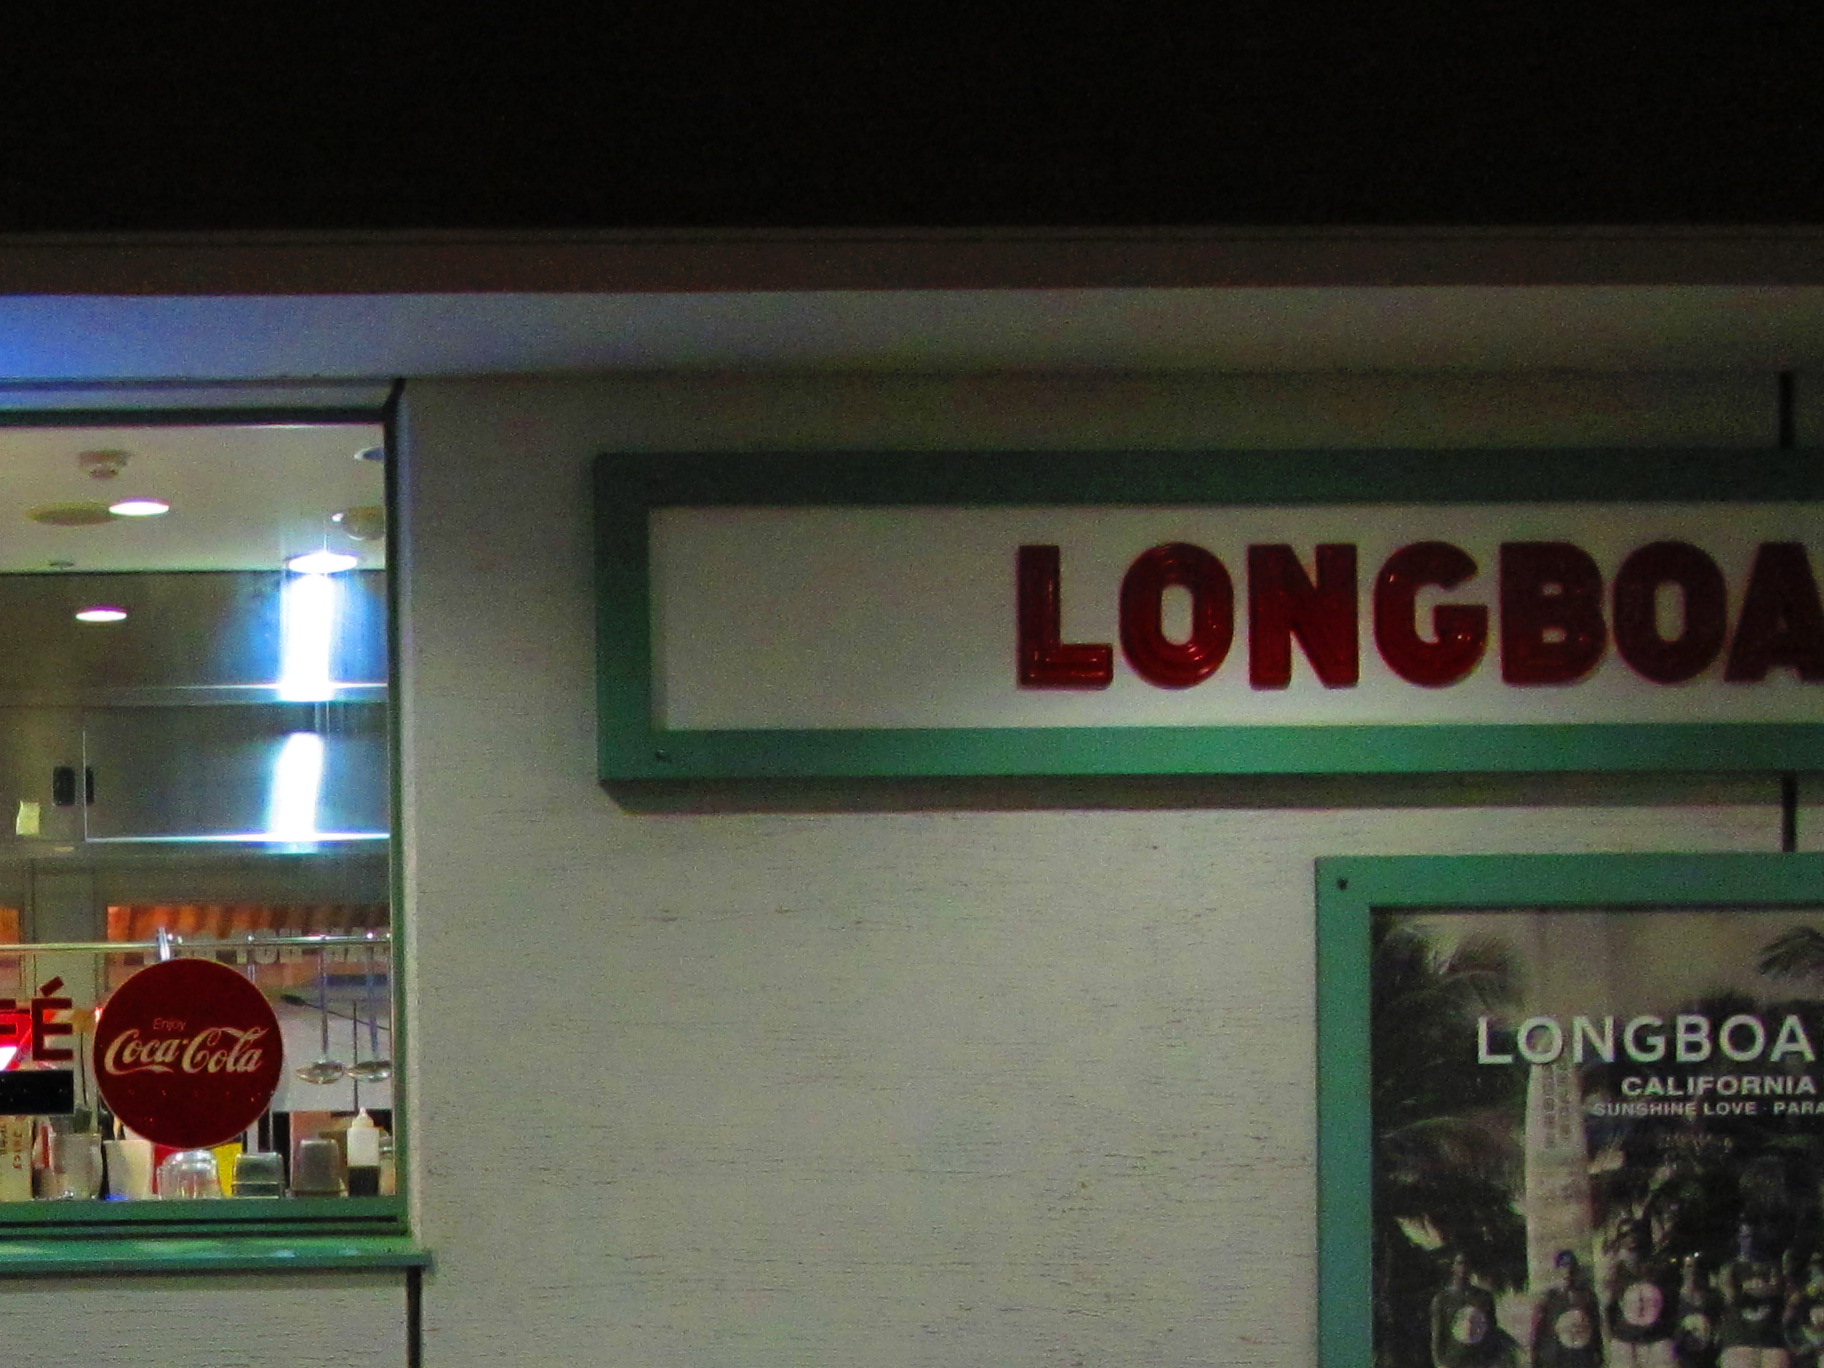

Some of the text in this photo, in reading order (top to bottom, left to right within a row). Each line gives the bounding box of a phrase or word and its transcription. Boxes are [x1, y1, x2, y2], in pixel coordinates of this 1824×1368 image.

[1017, 541, 1824, 689] LONGBOA
[153, 1017, 186, 1031] Enjoy
[1477, 1014, 1816, 1065] LONGBOA
[104, 1027, 269, 1075] Coca-Cola
[1622, 1076, 1817, 1096] CALIFORNIA
[1593, 1102, 1696, 1116] SUNSHINE
[1704, 1102, 1756, 1115] LOVE
